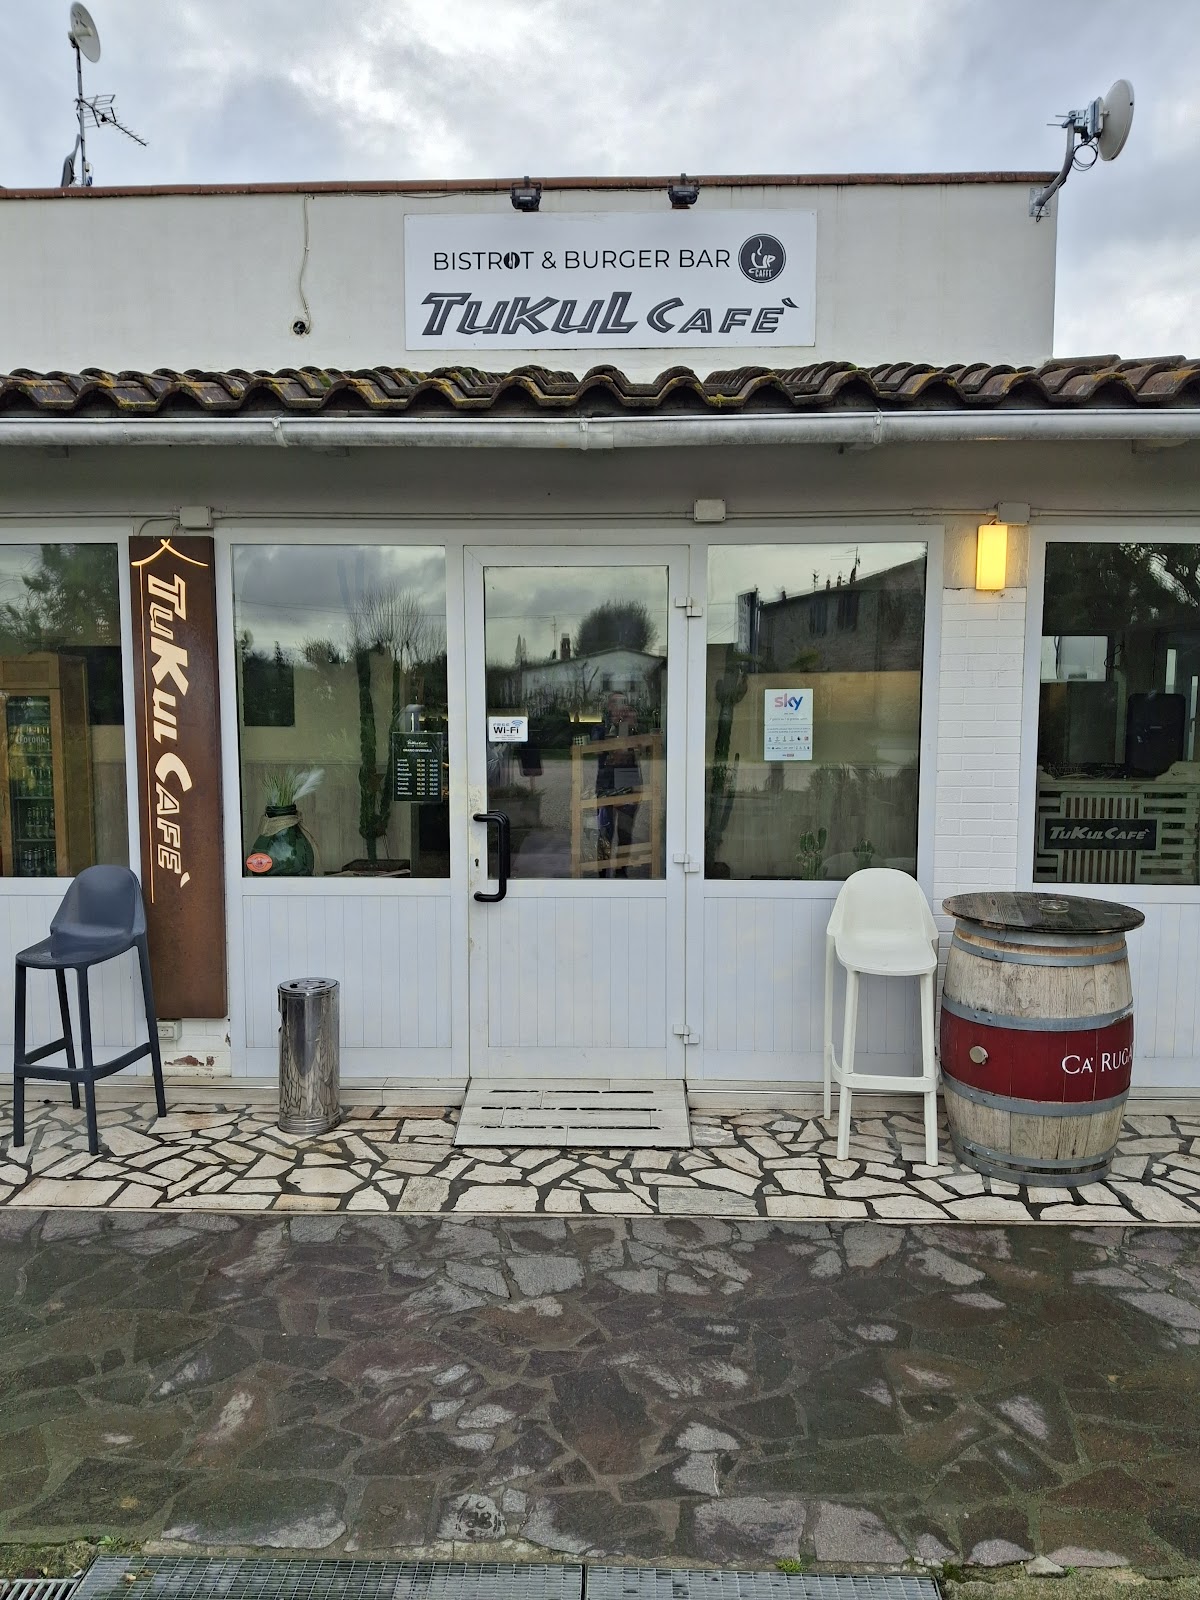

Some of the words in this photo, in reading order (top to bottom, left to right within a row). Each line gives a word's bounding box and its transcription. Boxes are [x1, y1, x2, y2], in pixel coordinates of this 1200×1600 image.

[433, 251, 534, 271] BISTROT
[541, 251, 557, 269] &
[564, 250, 670, 269] BURGER
[679, 249, 731, 268] BAR
[774, 692, 803, 711] sky
[1061, 1054, 1094, 1075] CA'
[1101, 1041, 1134, 1073] RUGA
